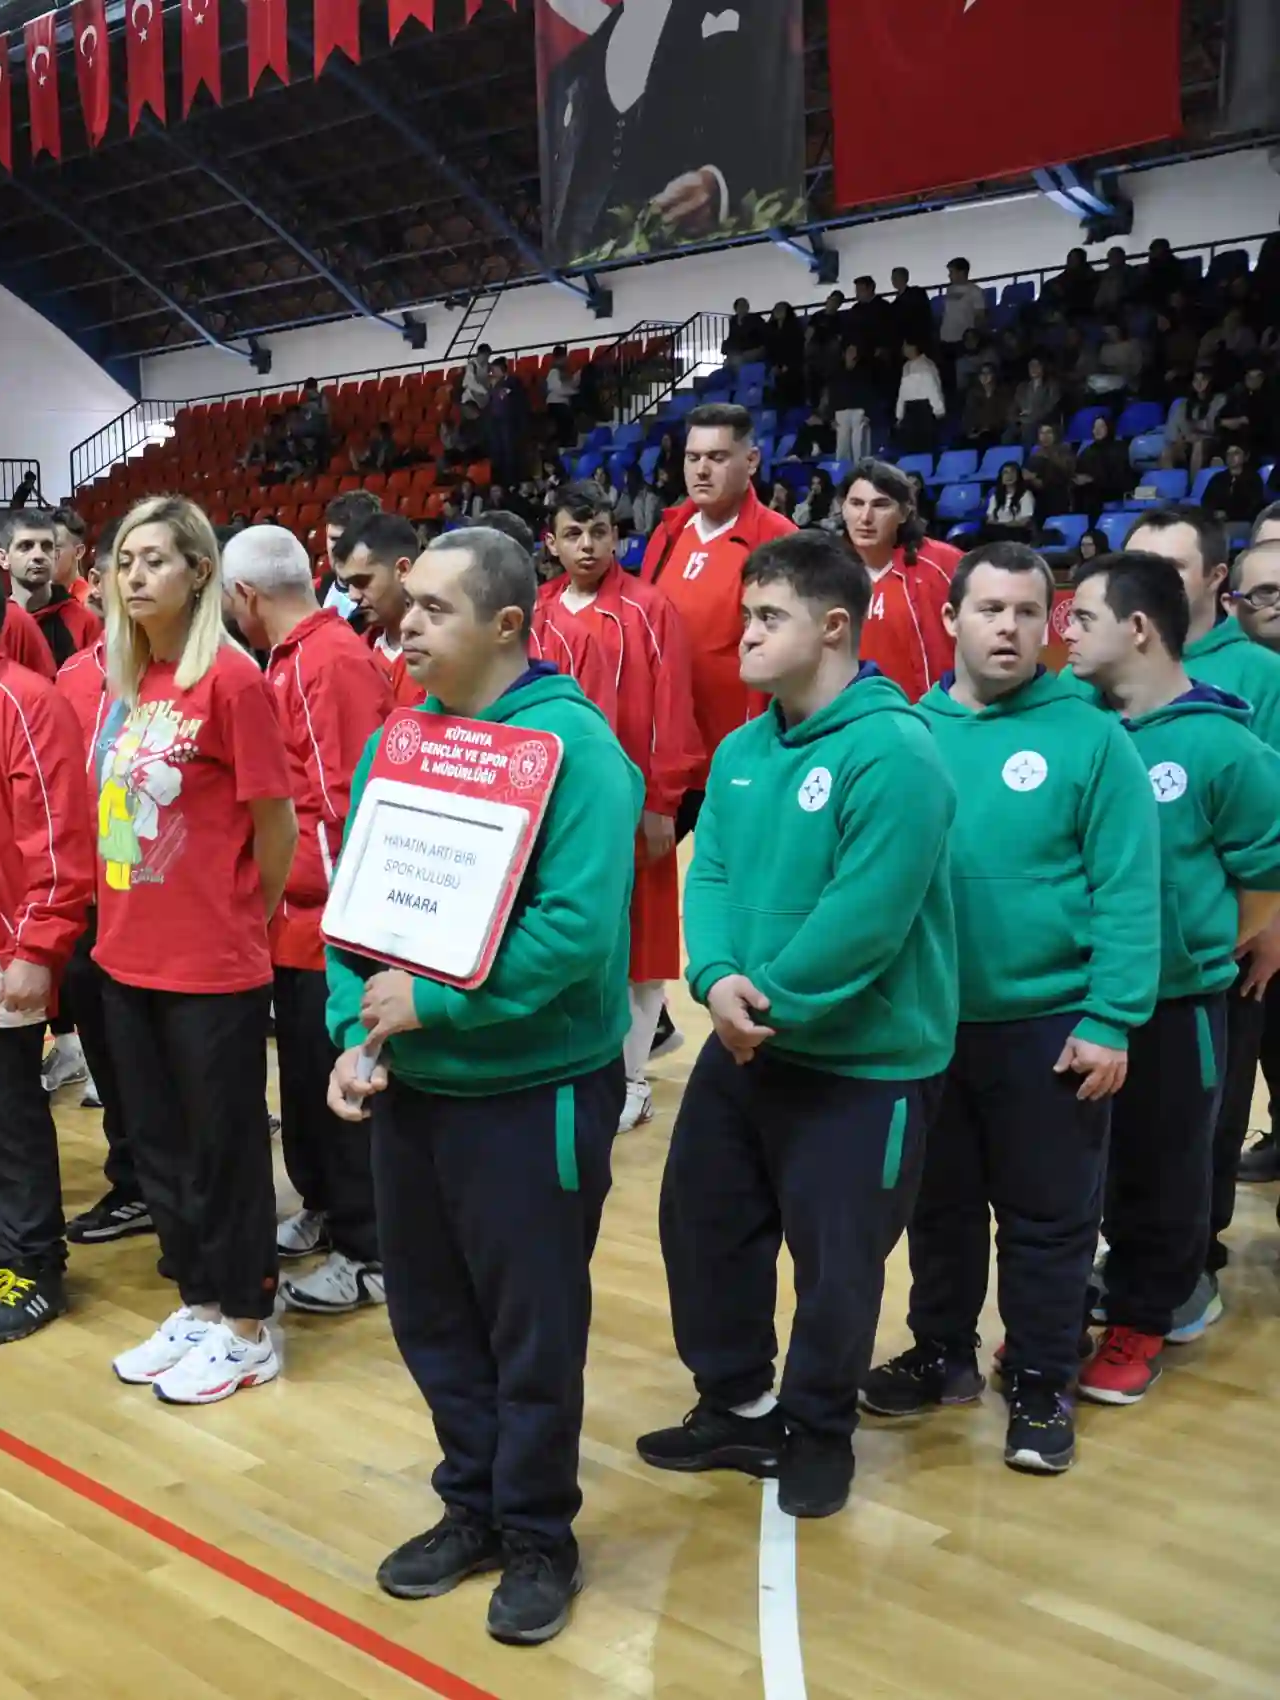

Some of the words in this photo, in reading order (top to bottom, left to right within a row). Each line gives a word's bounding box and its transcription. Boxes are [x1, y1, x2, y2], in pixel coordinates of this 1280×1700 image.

[682, 551, 709, 580] 15
[867, 592, 885, 621] 14
[465, 748, 478, 763] VE
[479, 751, 508, 768] SPOR
[383, 858, 416, 877] SPOR
[385, 887, 439, 916] ANKARA
